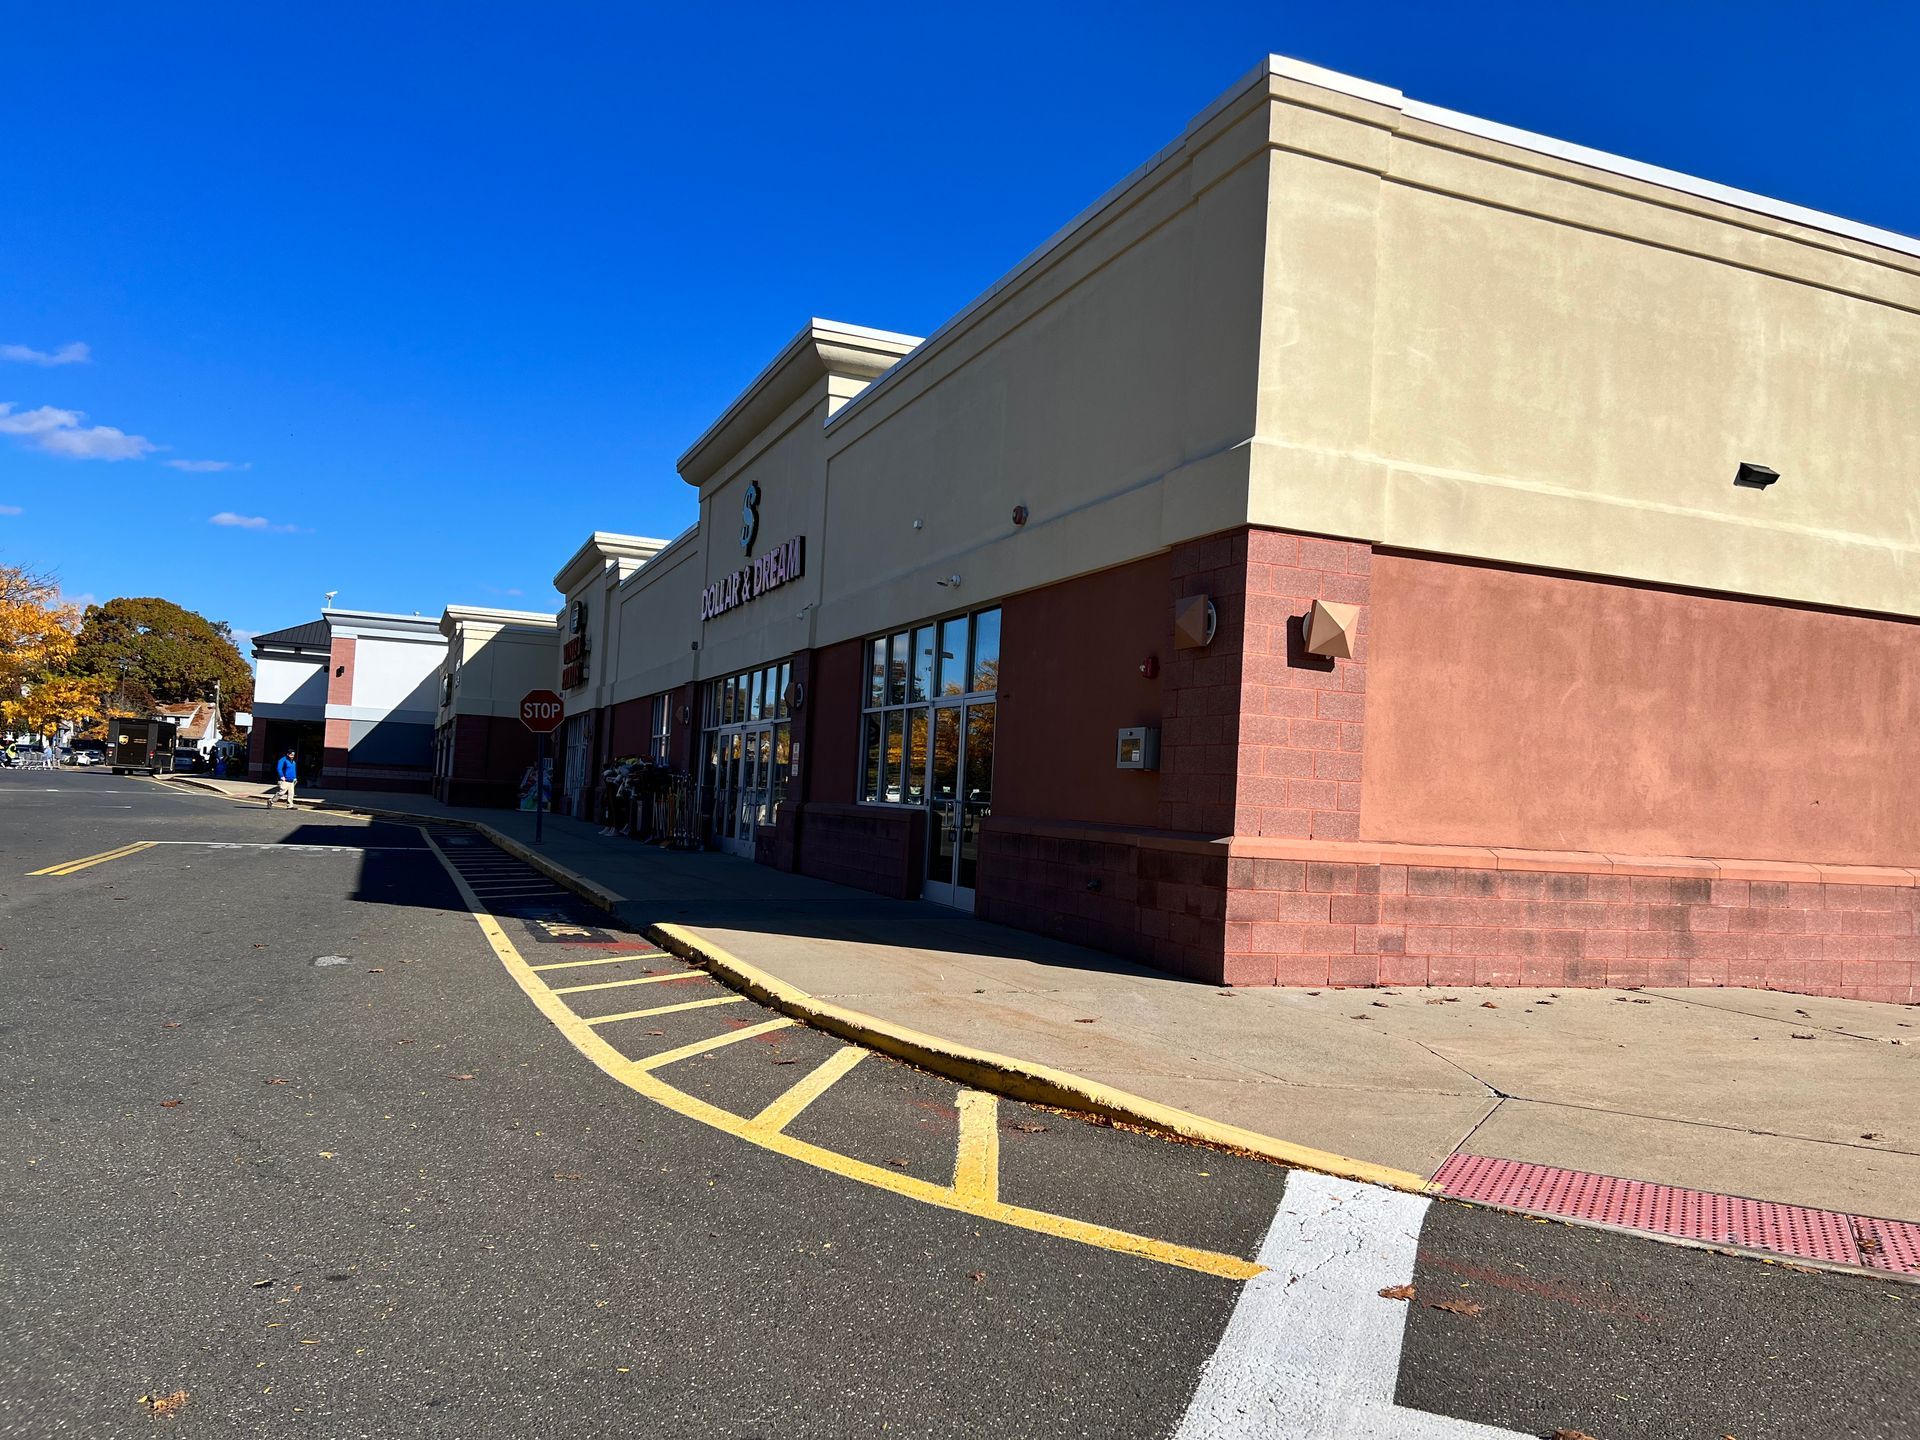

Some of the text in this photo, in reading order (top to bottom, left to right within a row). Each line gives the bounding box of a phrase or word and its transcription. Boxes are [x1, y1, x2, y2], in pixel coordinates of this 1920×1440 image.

[701, 536, 805, 621] DOLLAR & DREAM
[523, 702, 561, 719] STOP
